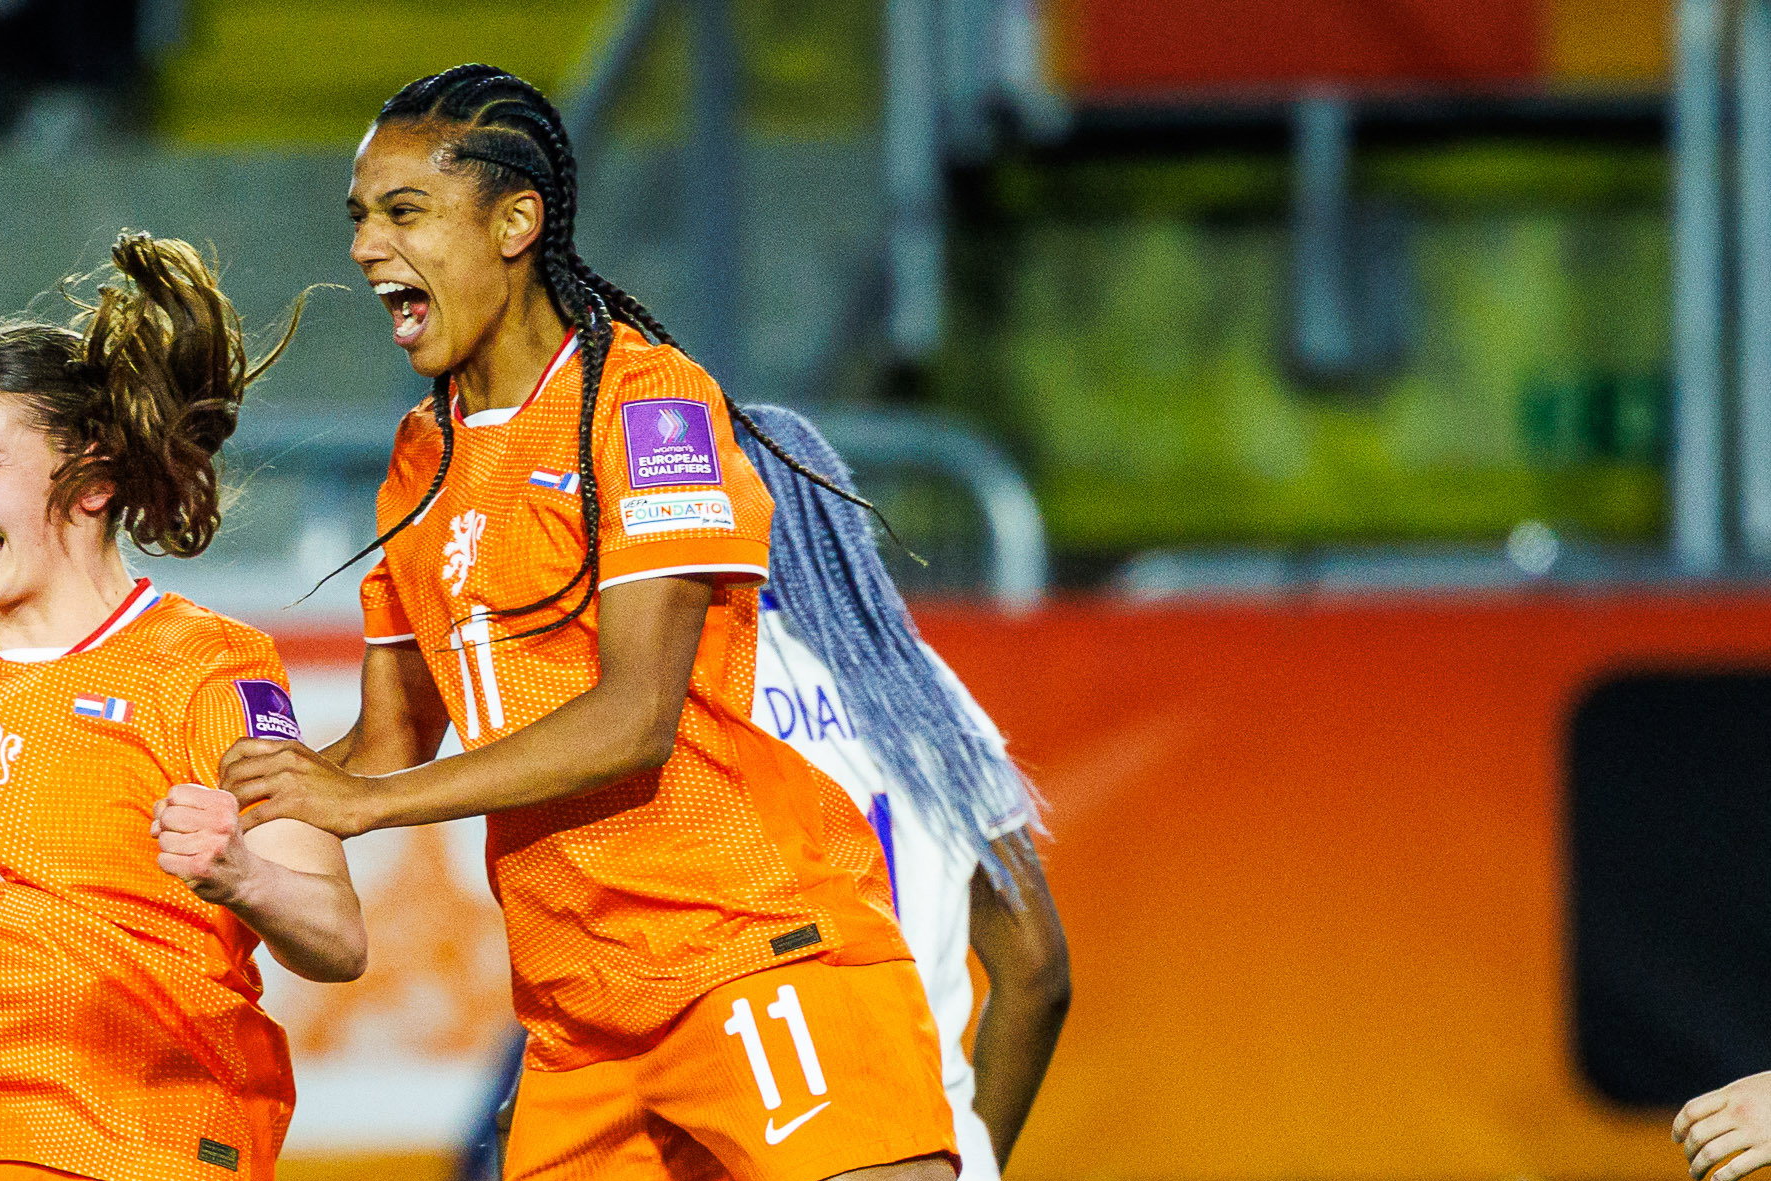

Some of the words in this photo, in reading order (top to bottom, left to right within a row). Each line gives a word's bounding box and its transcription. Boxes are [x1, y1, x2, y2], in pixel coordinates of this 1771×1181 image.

[638, 454, 709, 467] EUROPEAN
[638, 464, 712, 478] QUALIFIERS
[624, 498, 648, 509] UEFA
[449, 604, 505, 740] 11
[724, 984, 828, 1110] 11
